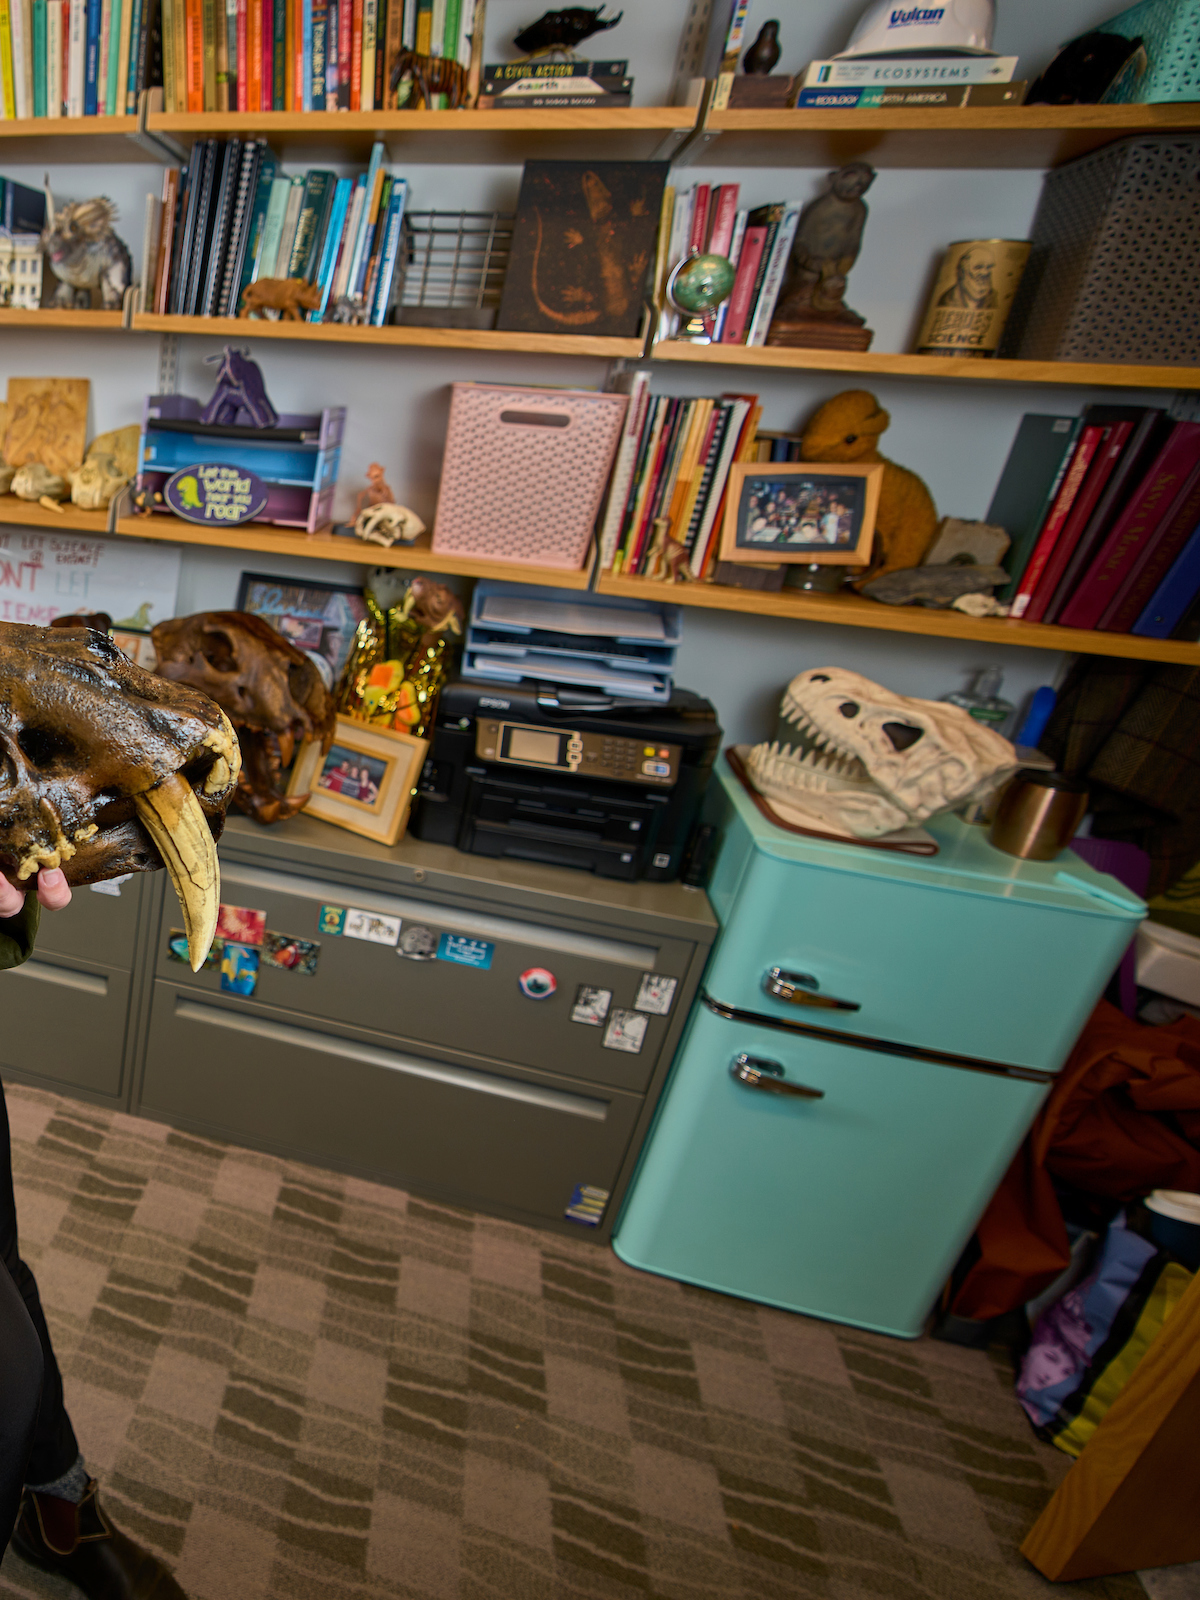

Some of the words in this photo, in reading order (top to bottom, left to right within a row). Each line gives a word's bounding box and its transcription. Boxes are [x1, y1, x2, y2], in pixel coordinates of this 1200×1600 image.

[890, 7, 945, 25] Vulcan
[494, 67, 503, 79] A
[505, 65, 533, 79] CIVIL
[535, 63, 574, 77] ACTION
[873, 66, 970, 80] ECOSYSTEMS
[815, 94, 859, 107] ECOLOGY
[870, 93, 904, 105] NORTH
[904, 91, 948, 104] AMERICA
[198, 465, 219, 479] Let
[203, 478, 251, 494] world
[205, 502, 247, 521] roar
[55, 571, 94, 599] LET
[478, 697, 511, 710] EPSON
